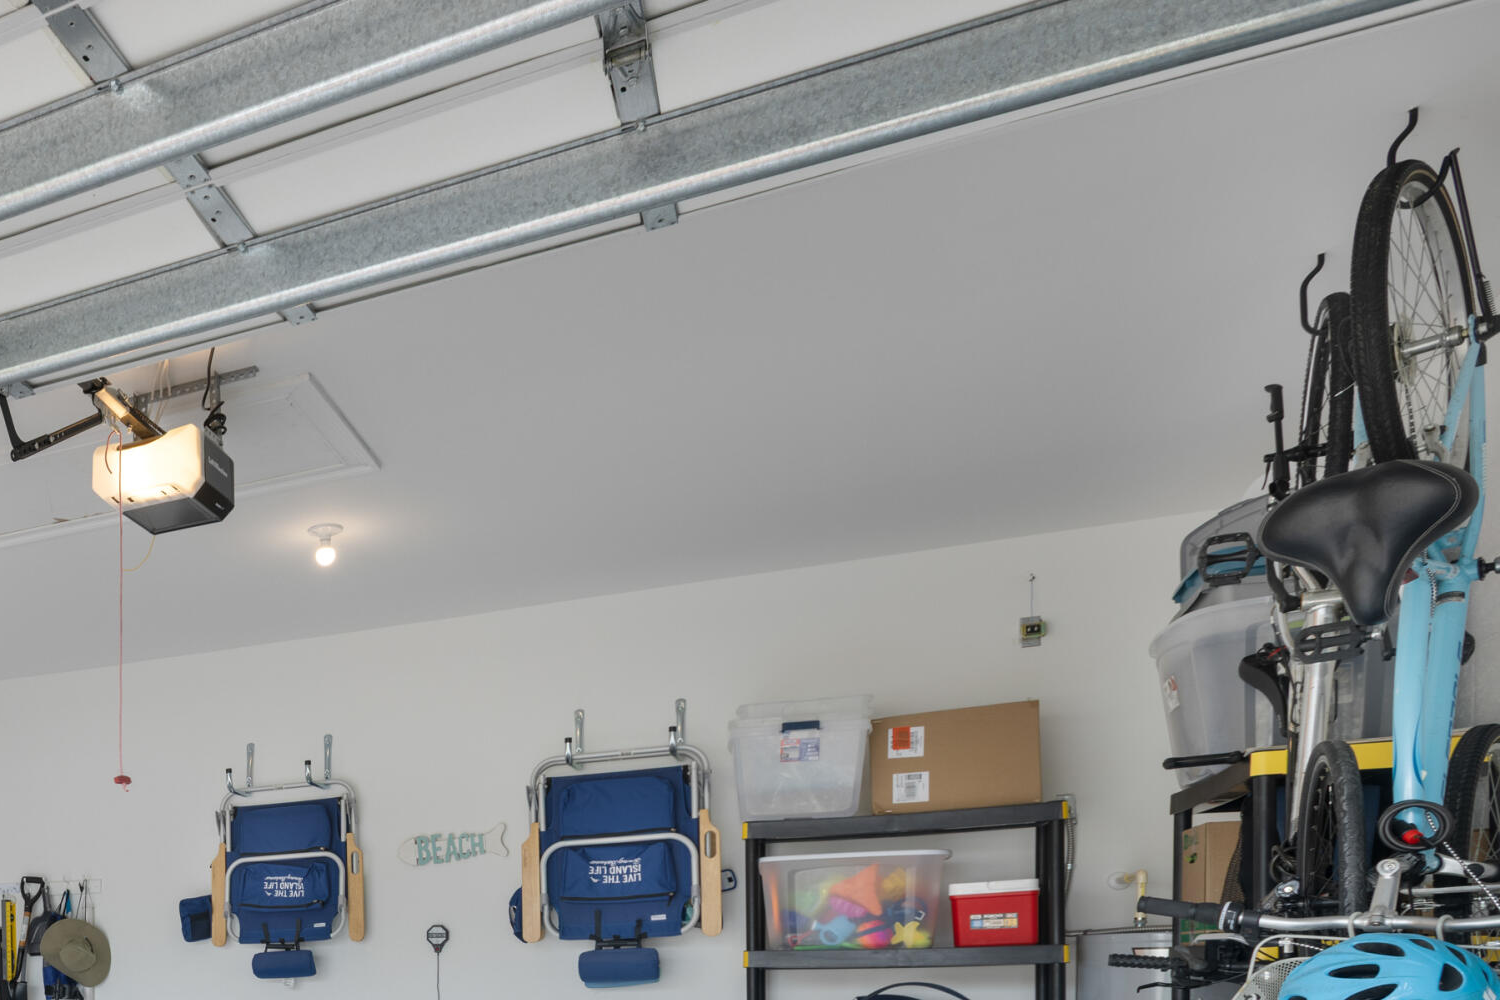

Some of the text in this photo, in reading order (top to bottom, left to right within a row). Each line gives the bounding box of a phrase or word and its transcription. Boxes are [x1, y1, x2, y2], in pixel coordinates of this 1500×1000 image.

[415, 832, 485, 866] BEACH
[588, 864, 642, 874] ISLAND LIFE
[602, 873, 642, 883] LIVE THE
[263, 881, 278, 889] LIFE
[288, 890, 305, 898] LIVE
